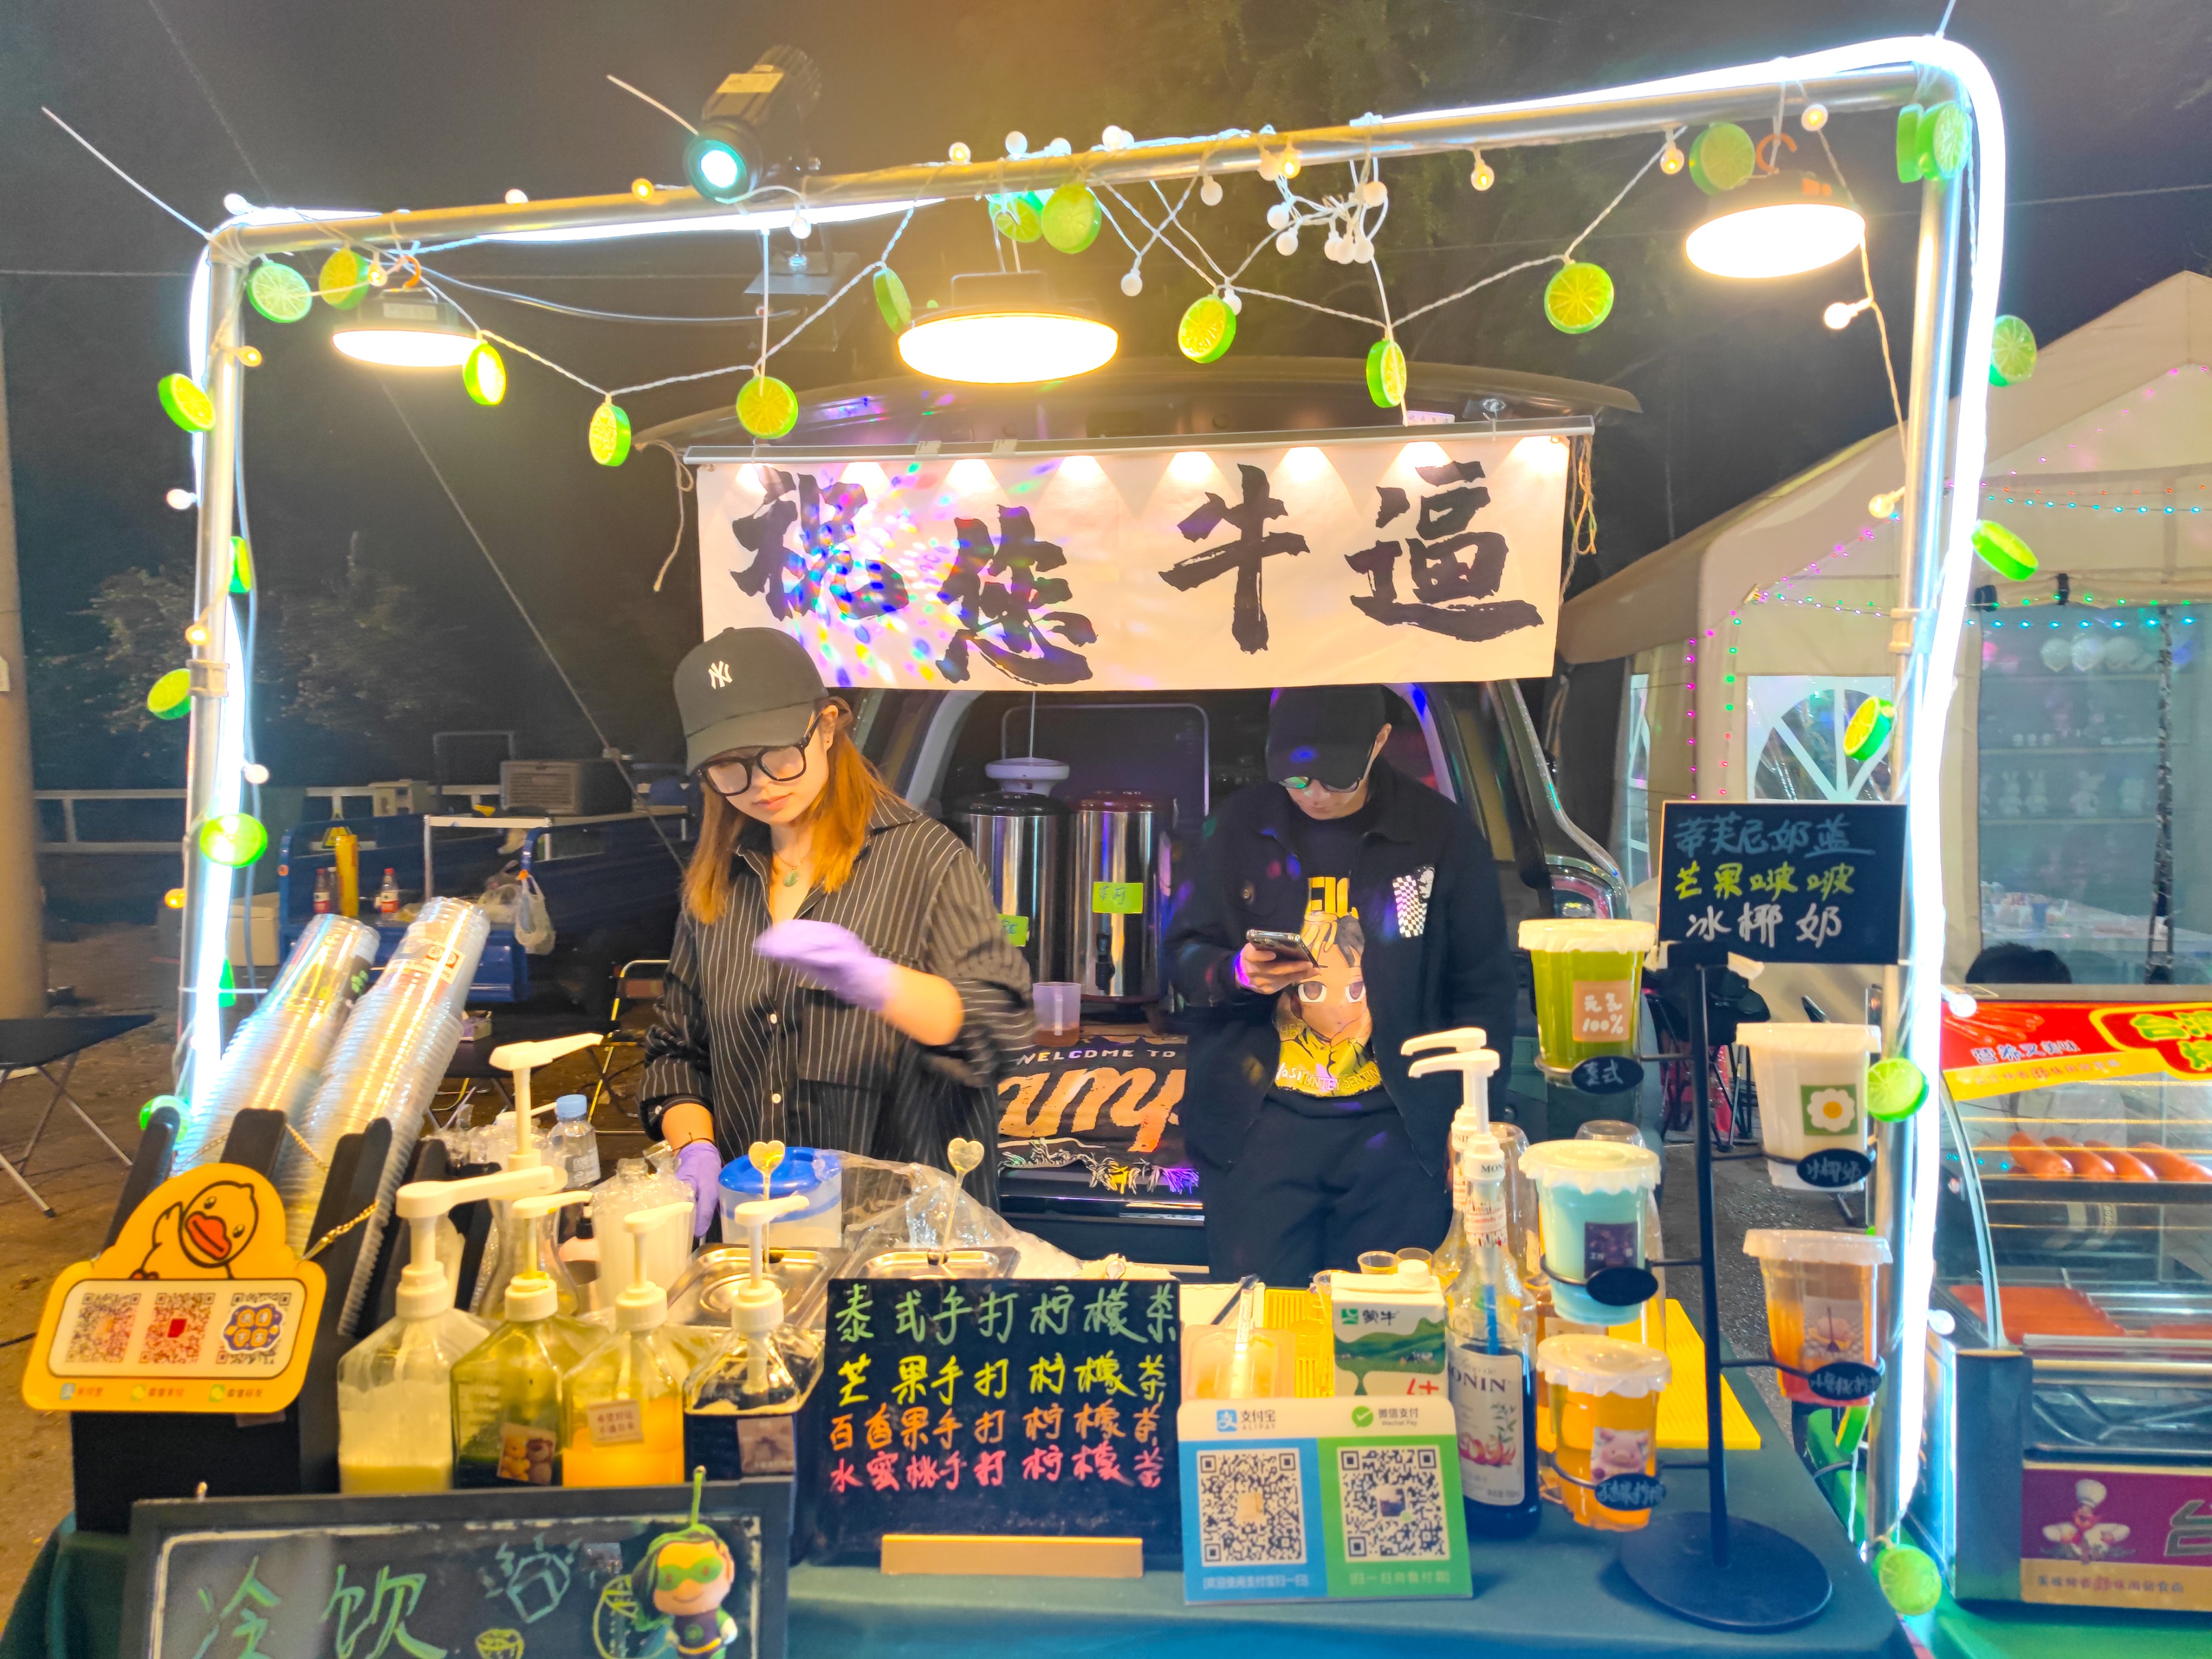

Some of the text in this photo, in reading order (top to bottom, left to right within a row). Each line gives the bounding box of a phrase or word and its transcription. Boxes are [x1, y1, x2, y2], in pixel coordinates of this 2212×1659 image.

[708, 661, 733, 689] NY
[1685, 901, 1842, 948] 冰椰奶
[1147, 1050, 1176, 1058] TO
[835, 1281, 1177, 1345] 泰式手打柠檬茶
[1362, 1309, 1399, 1326] 蒙牛
[838, 1350, 1167, 1406] 芒果手打柠檬茶
[830, 1399, 1160, 1451] 百香果手打柠檬茶
[1241, 1409, 1275, 1423] 支付宝
[830, 1441, 1164, 1493] 水蜜桃手打柠檬茶
